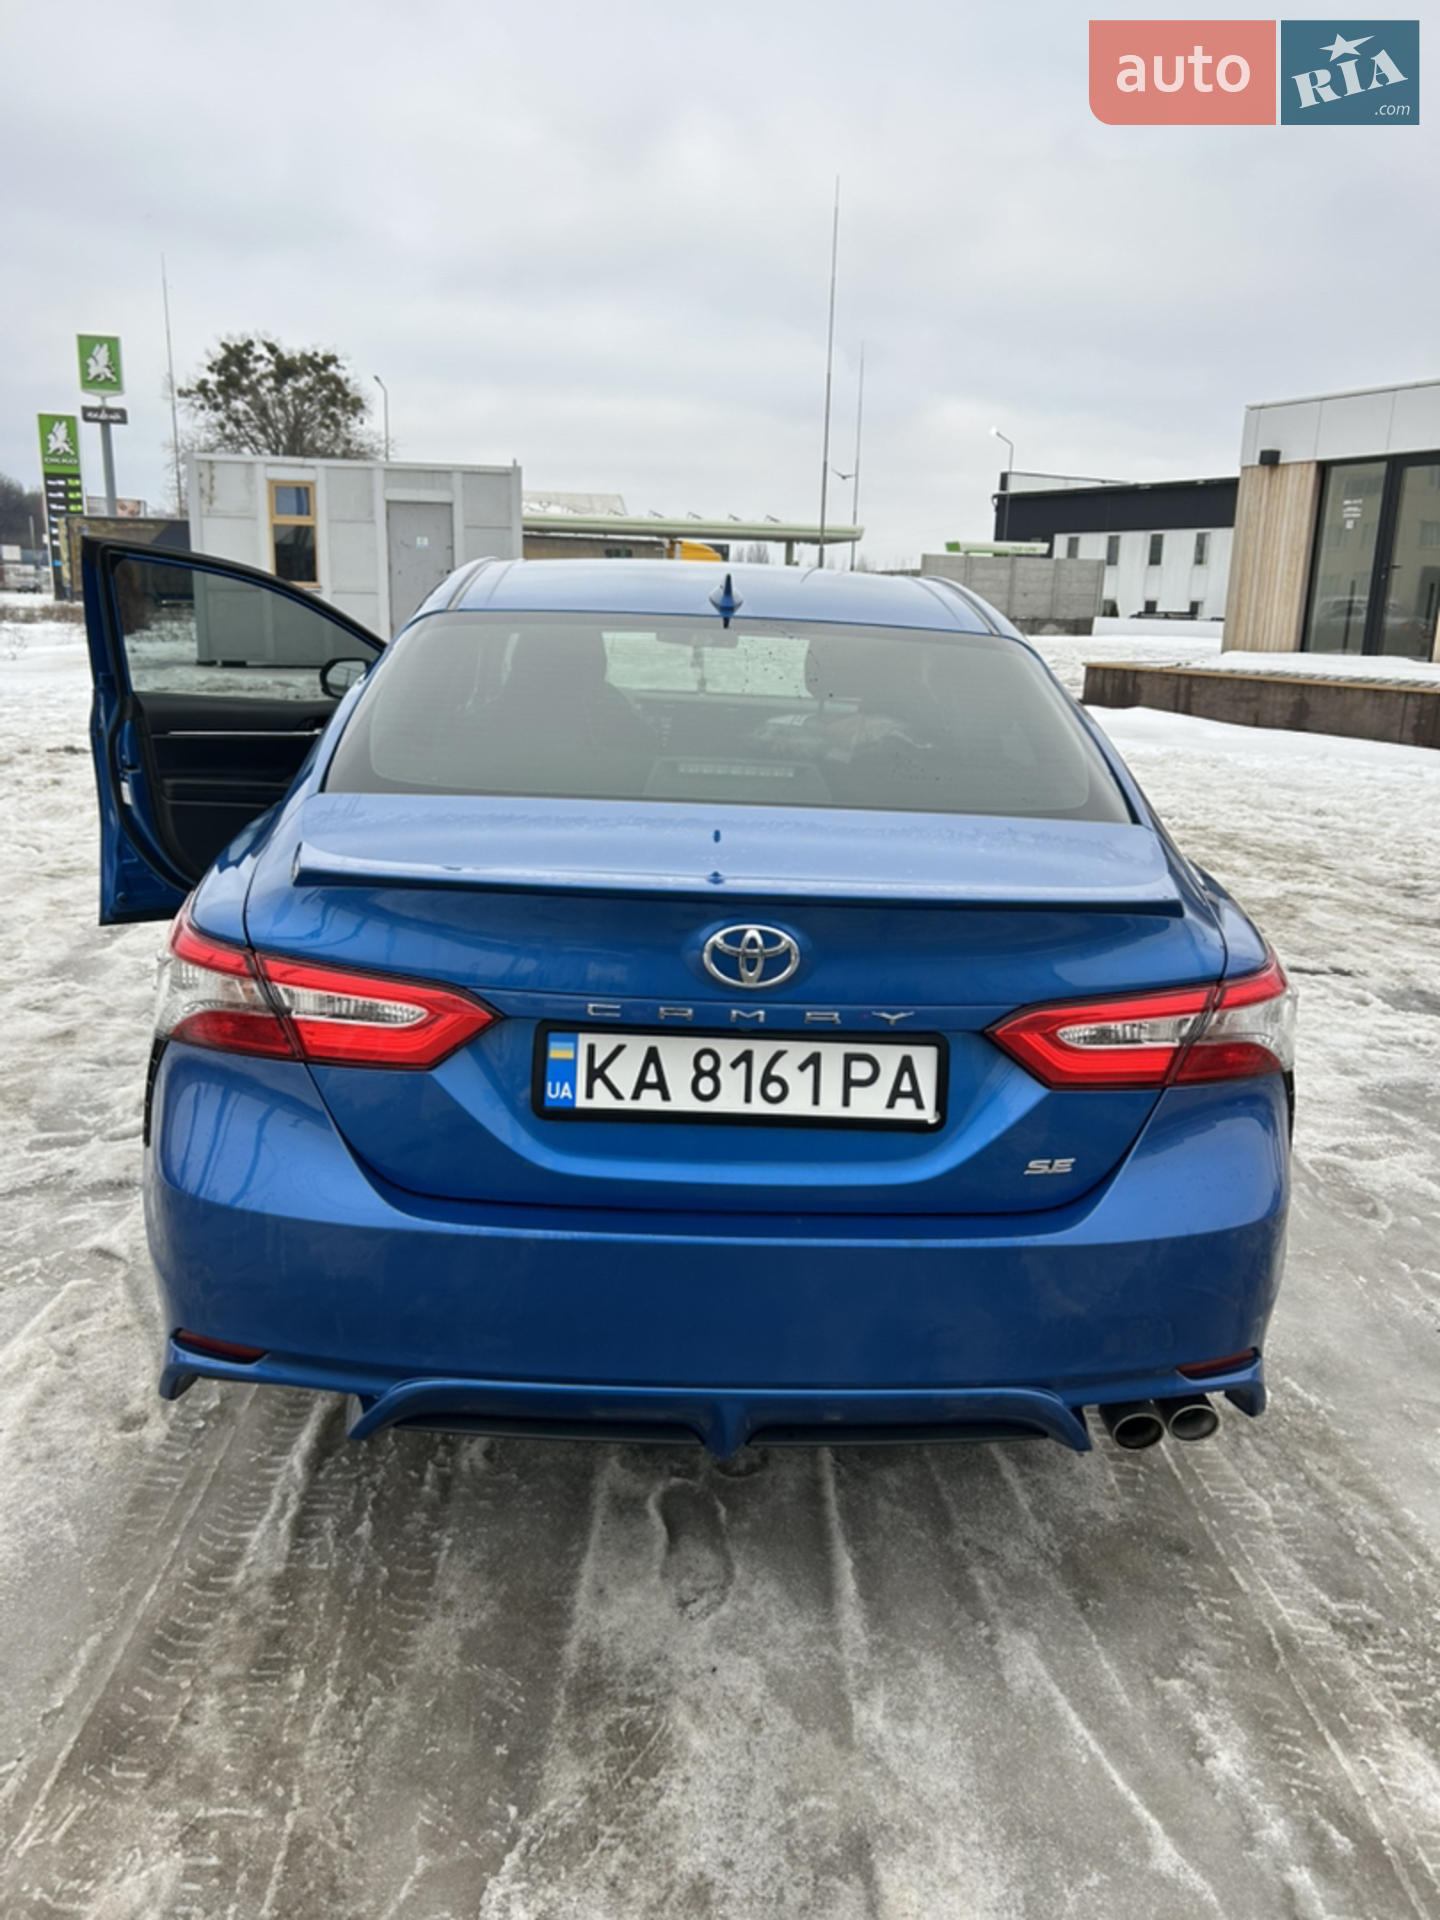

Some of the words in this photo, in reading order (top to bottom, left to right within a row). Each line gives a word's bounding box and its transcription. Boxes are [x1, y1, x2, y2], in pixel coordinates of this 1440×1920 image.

[586, 1002, 915, 1026] CAMRY
[584, 1043, 671, 1102] KA
[690, 1047, 822, 1107] 8161
[841, 1051, 925, 1110] PA
[547, 1081, 573, 1099] UA
[1023, 1157, 1076, 1175] SE
